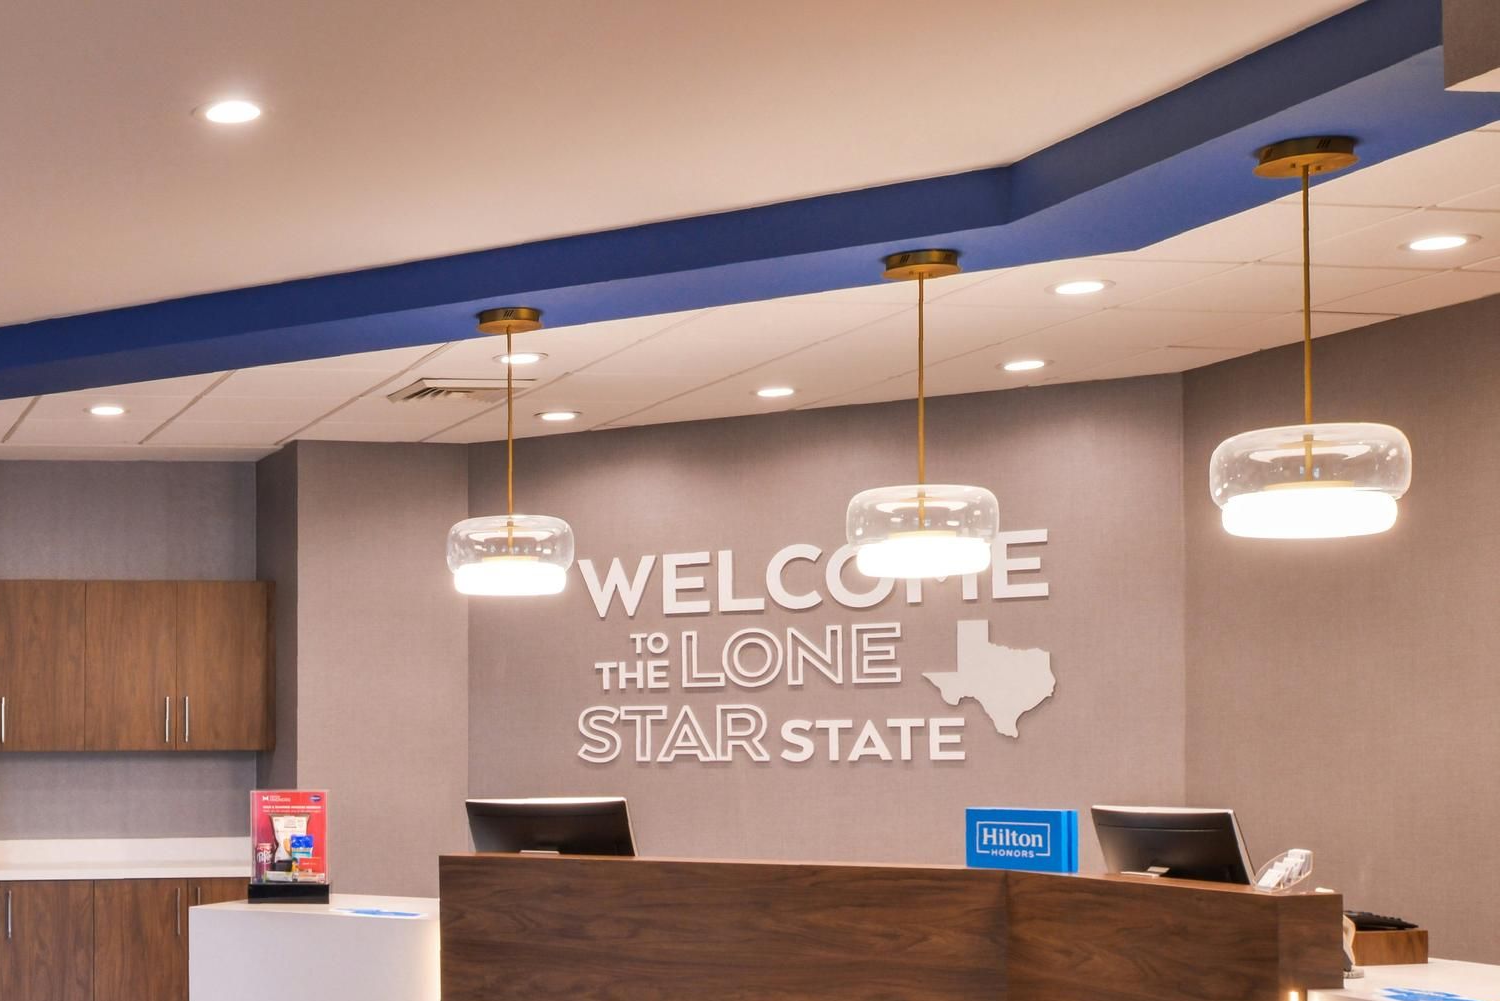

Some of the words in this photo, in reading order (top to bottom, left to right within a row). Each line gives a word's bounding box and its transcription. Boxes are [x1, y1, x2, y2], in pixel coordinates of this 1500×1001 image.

[630, 632, 669, 655] TO
[595, 660, 670, 690] THE
[681, 622, 902, 688] LONE
[577, 704, 770, 763] STAR
[781, 717, 966, 762] STATE
[982, 827, 1043, 848] Hilton
[991, 849, 1035, 858] HONORS
